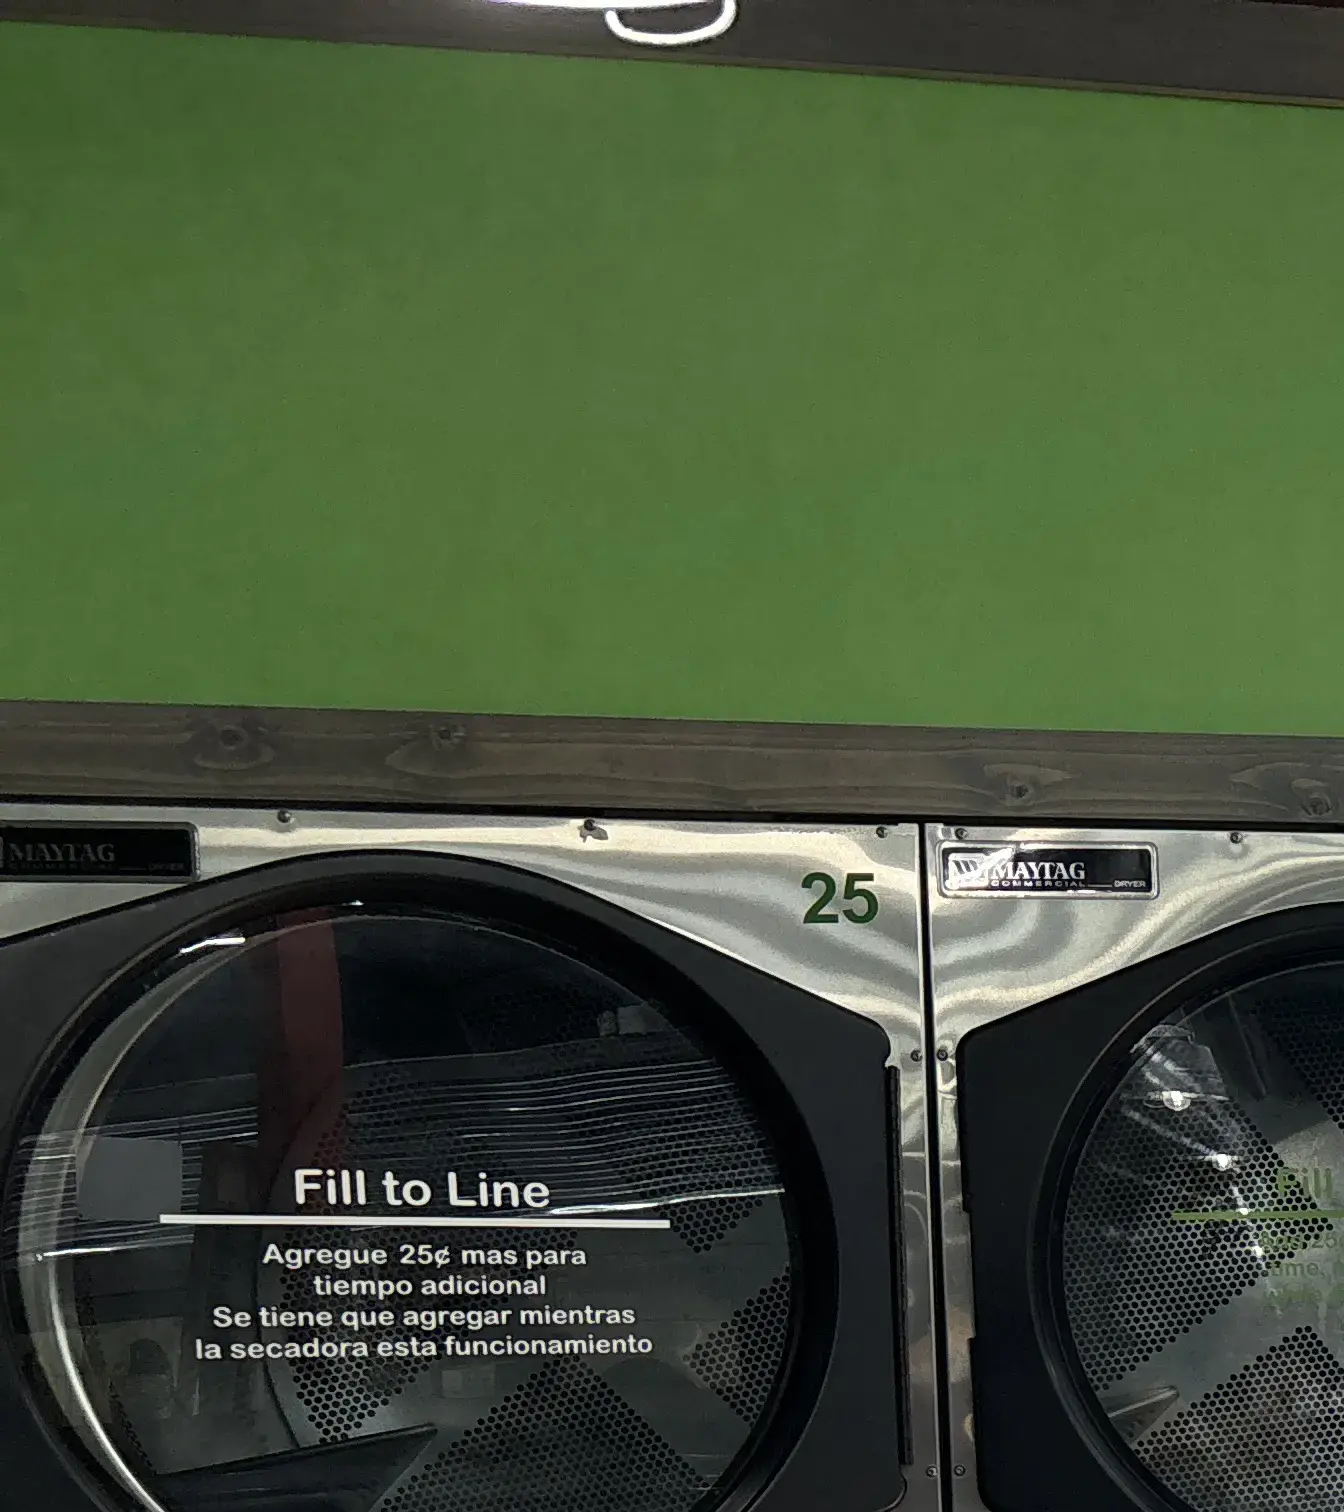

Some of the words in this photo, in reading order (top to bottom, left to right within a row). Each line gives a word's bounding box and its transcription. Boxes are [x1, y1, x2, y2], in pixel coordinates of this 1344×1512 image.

[9, 843, 115, 863] MAYTAG
[990, 861, 1085, 880] MAYTAG
[801, 872, 879, 924] 25
[295, 1169, 366, 1205] Fill
[382, 1174, 432, 1207] to
[447, 1171, 550, 1208] Line
[262, 1243, 387, 1270] Agregue
[399, 1245, 451, 1268] 25¢
[461, 1248, 518, 1266] mas
[526, 1247, 587, 1270] para
[313, 1276, 413, 1300] tiempo
[421, 1275, 546, 1296] adicional
[213, 1307, 252, 1328] Se
[259, 1306, 333, 1327] tiene
[341, 1310, 395, 1333] que
[402, 1308, 512, 1331] agregar
[519, 1304, 636, 1325] mientras
[195, 1338, 222, 1360] la
[230, 1338, 369, 1359] secadora
[376, 1339, 438, 1357] esta
[444, 1335, 654, 1356] funcionamiento
